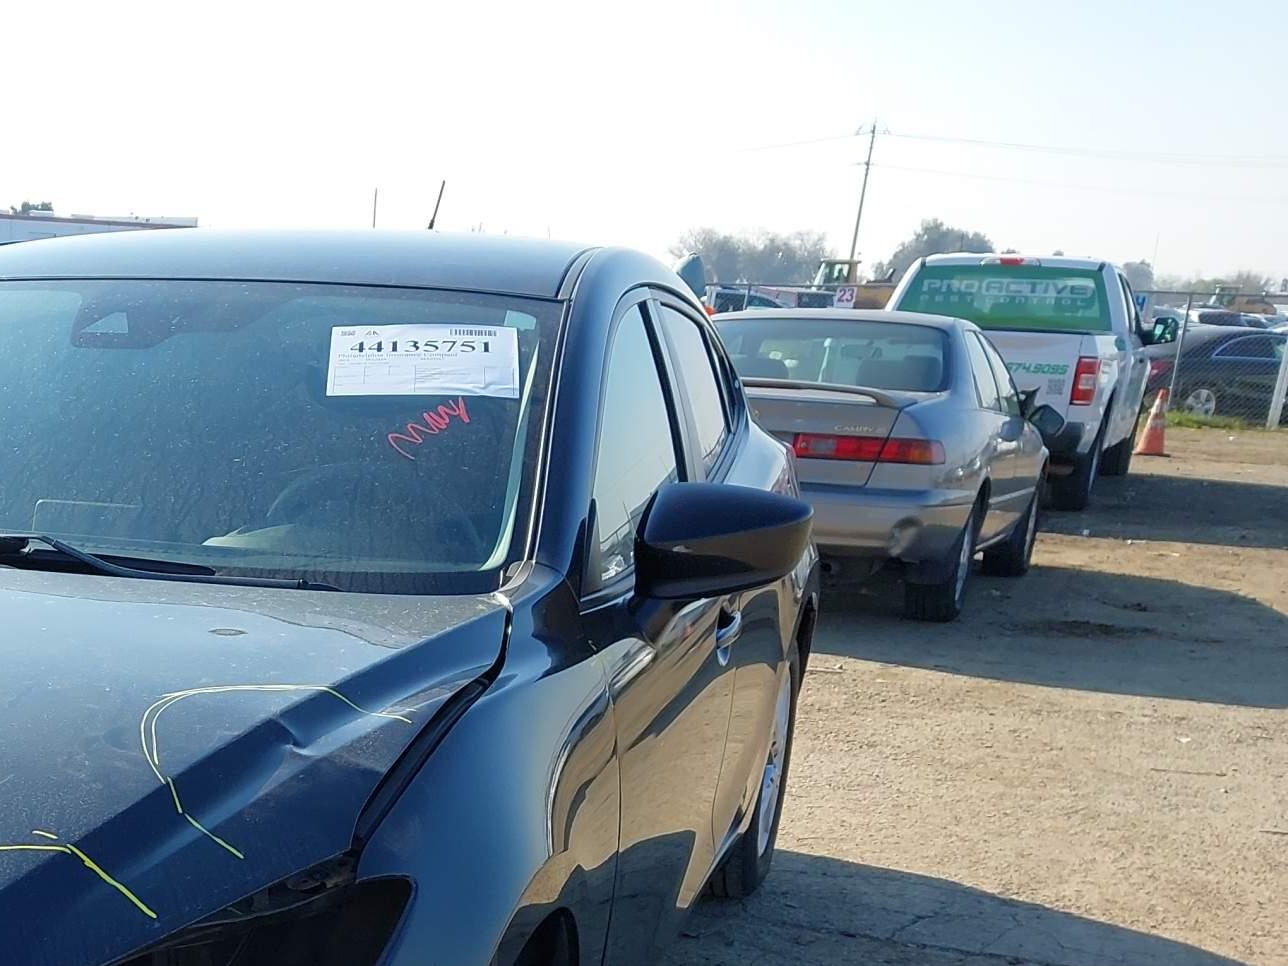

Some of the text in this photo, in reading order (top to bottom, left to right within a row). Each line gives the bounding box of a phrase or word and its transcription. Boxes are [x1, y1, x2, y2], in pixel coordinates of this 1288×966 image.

[922, 278, 1094, 297] PRO ACTIVE
[838, 288, 854, 303] 23
[350, 340, 491, 353] 44135751
